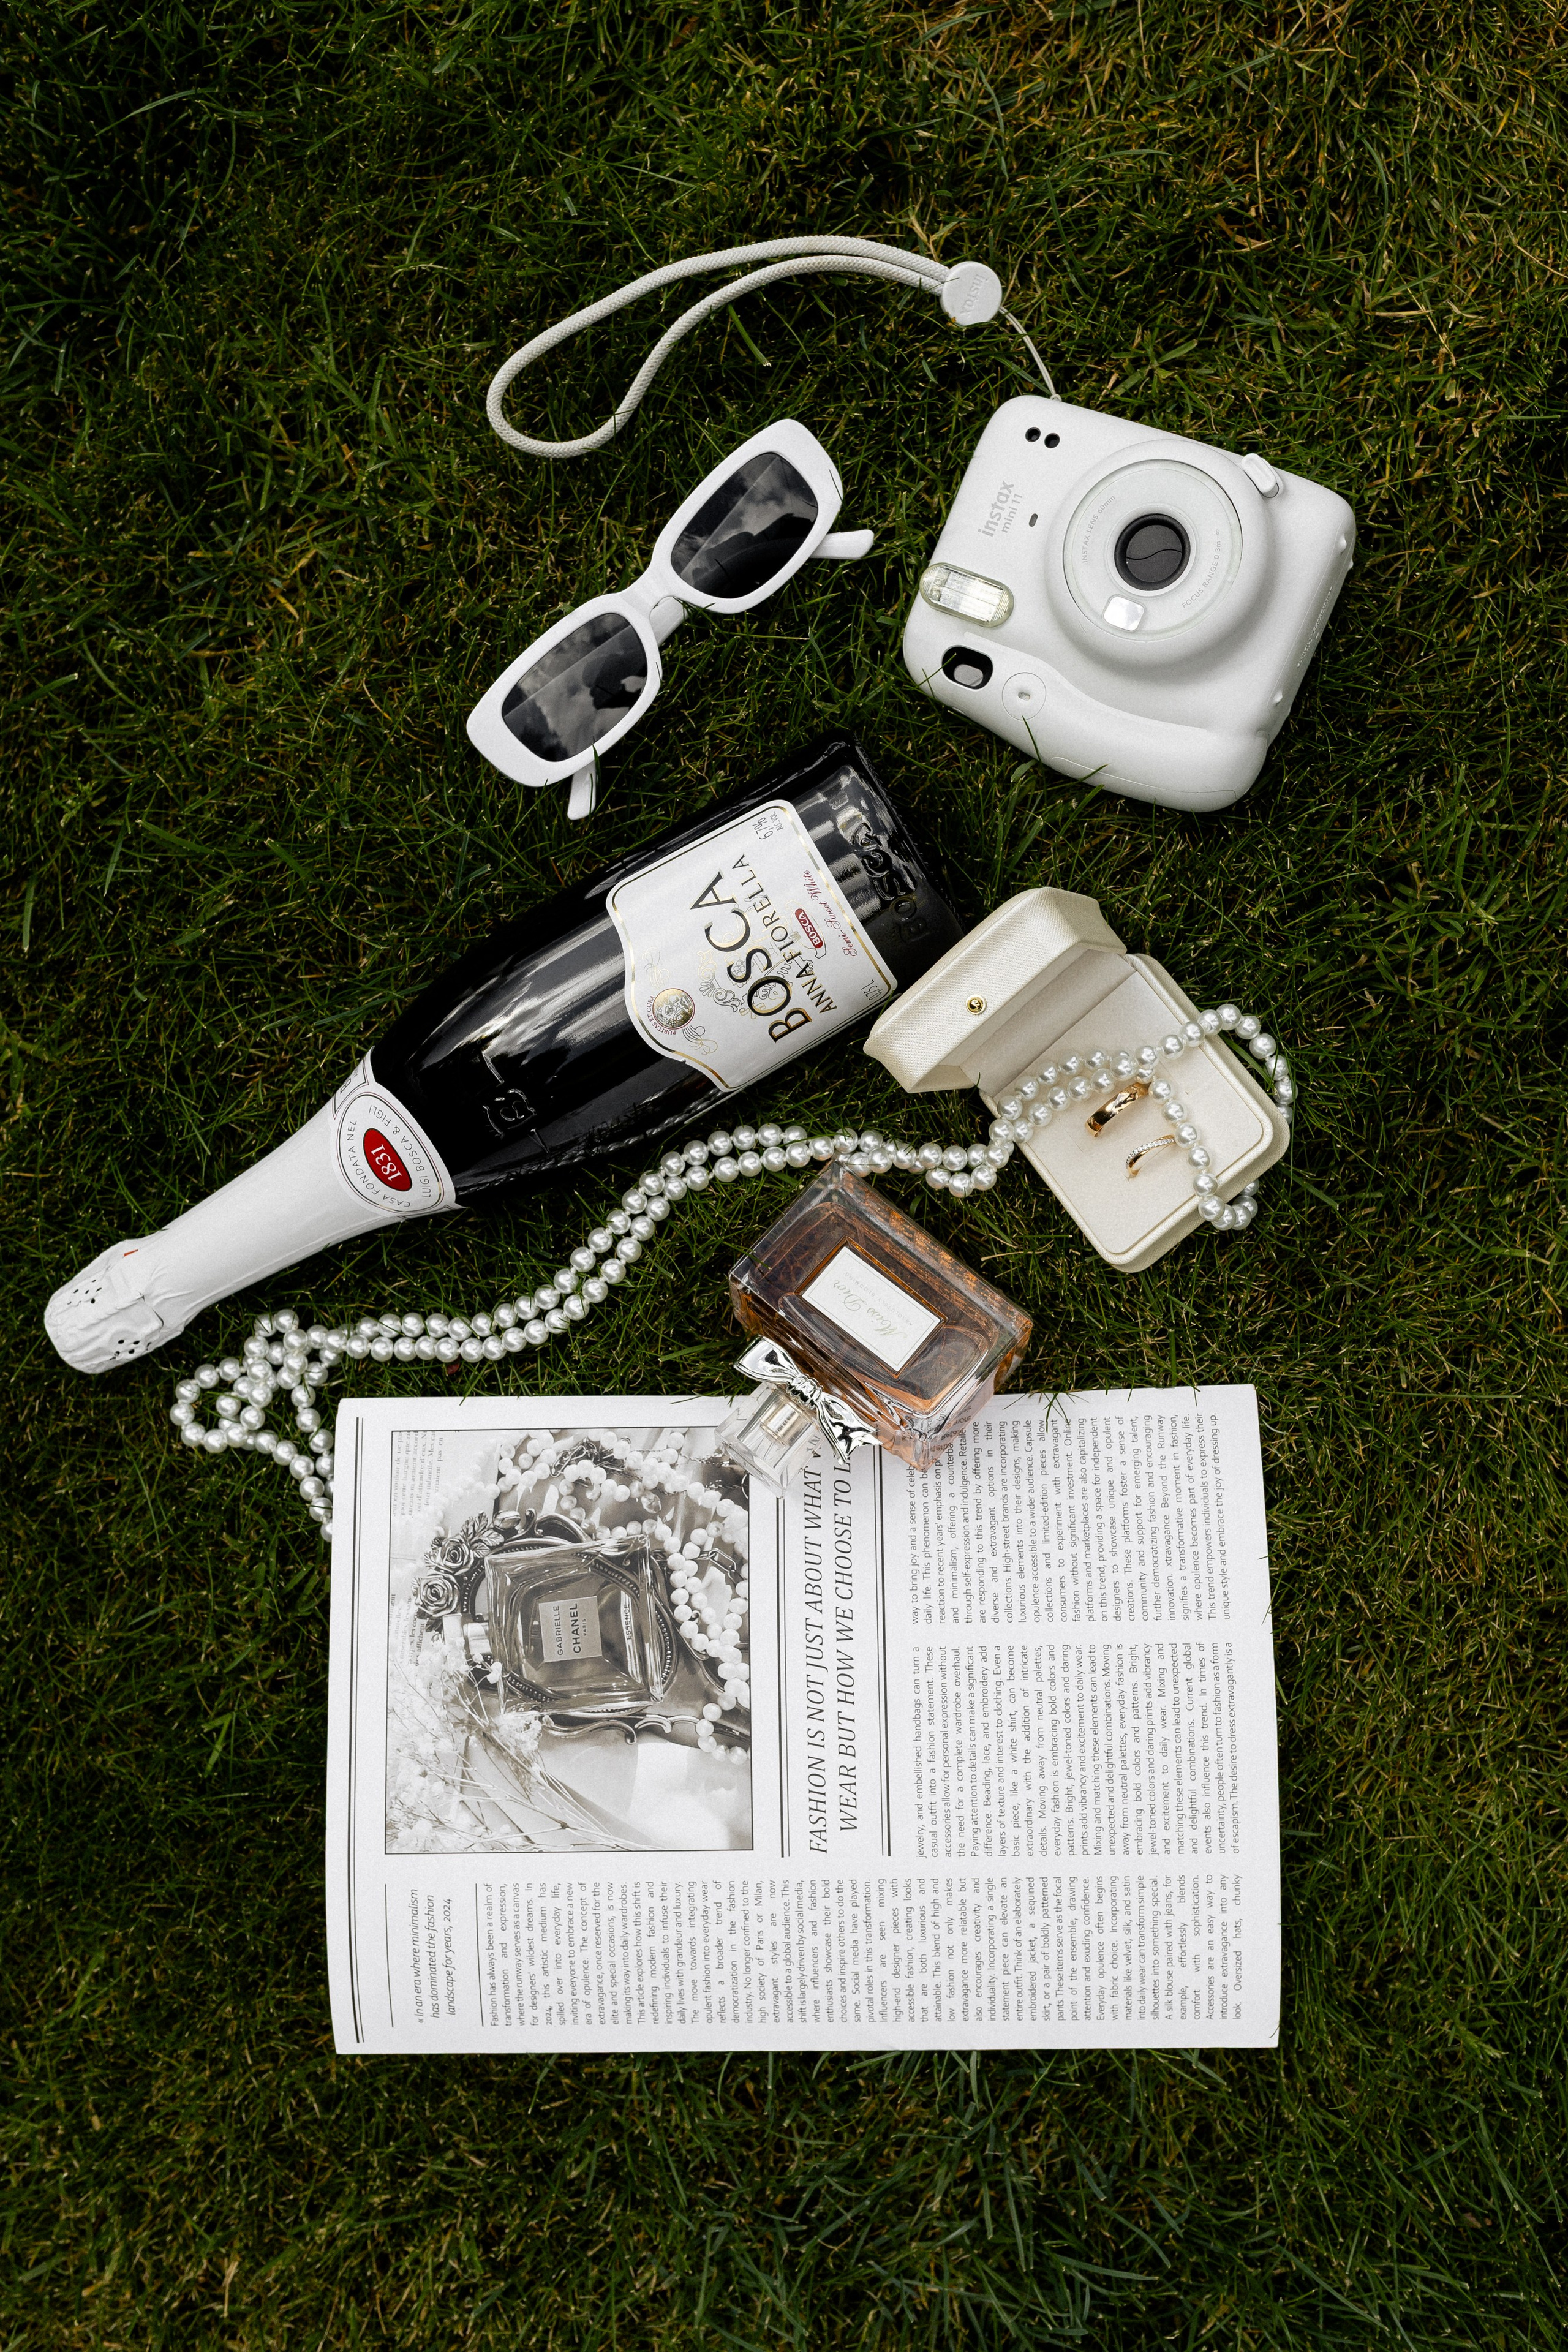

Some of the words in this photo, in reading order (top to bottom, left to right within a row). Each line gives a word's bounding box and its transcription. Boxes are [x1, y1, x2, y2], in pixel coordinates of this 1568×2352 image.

[978, 480, 1014, 537] instax
[1001, 506, 1017, 533] mini
[1011, 493, 1022, 504] 11
[1082, 535, 1090, 564] INSTAX
[1086, 514, 1098, 533] LENS
[1097, 496, 1115, 514] 60mm
[1182, 588, 1204, 609] FOCUS
[1202, 562, 1218, 588] RANGE
[752, 817, 774, 840] 6,7%
[770, 811, 778, 823] VOL
[774, 820, 784, 831] ALC
[803, 870, 822, 901] White
[732, 854, 802, 963] FIORELLA
[799, 911, 821, 946] BOSCA
[819, 900, 858, 957] Semi-Sweet
[690, 869, 812, 1043] BOSCA
[796, 962, 837, 1014] ANNA
[646, 996, 655, 1012] CURA
[652, 1022, 676, 1035] PURITAS
[347, 1120, 357, 1141] NEL
[368, 1105, 391, 1126] FIGLI
[393, 1125, 401, 1134] &
[371, 1144, 402, 1181] 1831
[401, 1136, 425, 1172] BOSCA
[347, 1146, 380, 1195] FONDATA
[383, 1194, 410, 1207] CASA
[419, 1175, 431, 1198] LUIGI
[833, 1280, 867, 1311] Dior
[845, 1272, 875, 1297] BLOOMING
[867, 1308, 908, 1338] Miss
[984, 1421, 993, 1441] their
[1156, 1414, 1166, 1449] Runway
[1210, 1412, 1219, 1426] up.
[1211, 1428, 1220, 1464] dressing
[1158, 1455, 1167, 1470] the
[1211, 1465, 1221, 1475] of
[833, 1479, 851, 1507] TO
[987, 1466, 997, 1498] options
[1158, 1476, 1171, 1508] Beyond
[1215, 1477, 1225, 1491] joy
[802, 1466, 822, 1530] WHAT
[1214, 1492, 1223, 1507] the
[987, 1506, 999, 1557] extravagant
[1163, 1514, 1174, 1567] xtravagance
[1216, 1509, 1226, 1547] embrace
[834, 1513, 853, 1600] CHOOSE
[1216, 1549, 1227, 1566] and
[804, 1536, 823, 1615] ABOUT
[989, 1566, 998, 1583] and
[1218, 1568, 1230, 1589] style
[990, 1593, 1000, 1623] diverse
[1166, 1573, 1176, 1621] innovation.
[1222, 1590, 1232, 1620] unique
[552, 1605, 564, 1656] GABRIELLE
[569, 1602, 581, 1654] CHANEL
[623, 1604, 633, 1640] ESSENCE
[835, 1606, 854, 1643] WE
[805, 1617, 829, 1673] JUST
[1195, 1642, 1205, 1652] of
[835, 1648, 855, 1706] HOW
[1006, 1645, 1016, 1681] become
[806, 1673, 825, 1723] NOT
[1199, 1688, 1207, 1697] In
[912, 1698, 924, 1742] handbags
[1007, 1710, 1018, 1732] shirt,
[1198, 1703, 1208, 1730] trend.
[807, 1728, 826, 1749] IS
[837, 1710, 856, 1758] BUT
[1200, 1735, 1209, 1751] this
[1008, 1738, 1017, 1763] white
[913, 1746, 923, 1800] embellished
[1200, 1757, 1210, 1796] influence
[838, 1765, 858, 1831] WEAR
[1009, 1781, 1019, 1796] like
[807, 1755, 827, 1854] FASHION
[914, 1803, 924, 1820] and
[1012, 1803, 1022, 1828] piece,
[1202, 1802, 1212, 1820] also
[915, 1825, 927, 1859] jewelry,
[1011, 1834, 1020, 1856] basic
[1204, 1825, 1212, 1855] events
[483, 1883, 492, 1893] of
[821, 1879, 831, 1899] bold
[878, 1879, 887, 1907] mixing
[1094, 1875, 1106, 1904] begins
[1231, 1874, 1243, 1906] chunky
[408, 1889, 420, 1947] minimalism
[424, 1895, 439, 1933] fashion
[443, 1899, 453, 1923] 2024
[484, 1894, 493, 1920] realm
[525, 1898, 534, 1932] dreams.
[822, 1905, 831, 1926] their
[1095, 1911, 1104, 1934] often
[1232, 1918, 1243, 1939] hats,
[425, 1933, 436, 1949] the
[443, 1926, 456, 1955] years,
[485, 1929, 494, 1950] been
[526, 1937, 535, 1967] wildest
[823, 1932, 833, 1973] showcase
[410, 1948, 421, 1977] where
[442, 1954, 456, 1971] for
[486, 1952, 497, 1980] always
[1095, 1941, 1107, 1979] opulence
[1232, 1950, 1242, 1991] Oversized
[413, 1979, 422, 1994] era
[425, 1950, 439, 2002] dominated
[488, 1981, 497, 1996] has
[415, 1996, 423, 2007] an
[444, 1970, 456, 2015] landscape
[527, 1972, 540, 2011] designers'
[824, 1980, 834, 2023] enthusiasts
[878, 1980, 888, 2022] Influencers
[1096, 1985, 1107, 2021] Everyday
[414, 2008, 424, 2017] In
[430, 2002, 440, 2018] has
[489, 1997, 499, 2026] Fashion
[529, 2015, 539, 2026] for
[1232, 2002, 1242, 2019] look.
